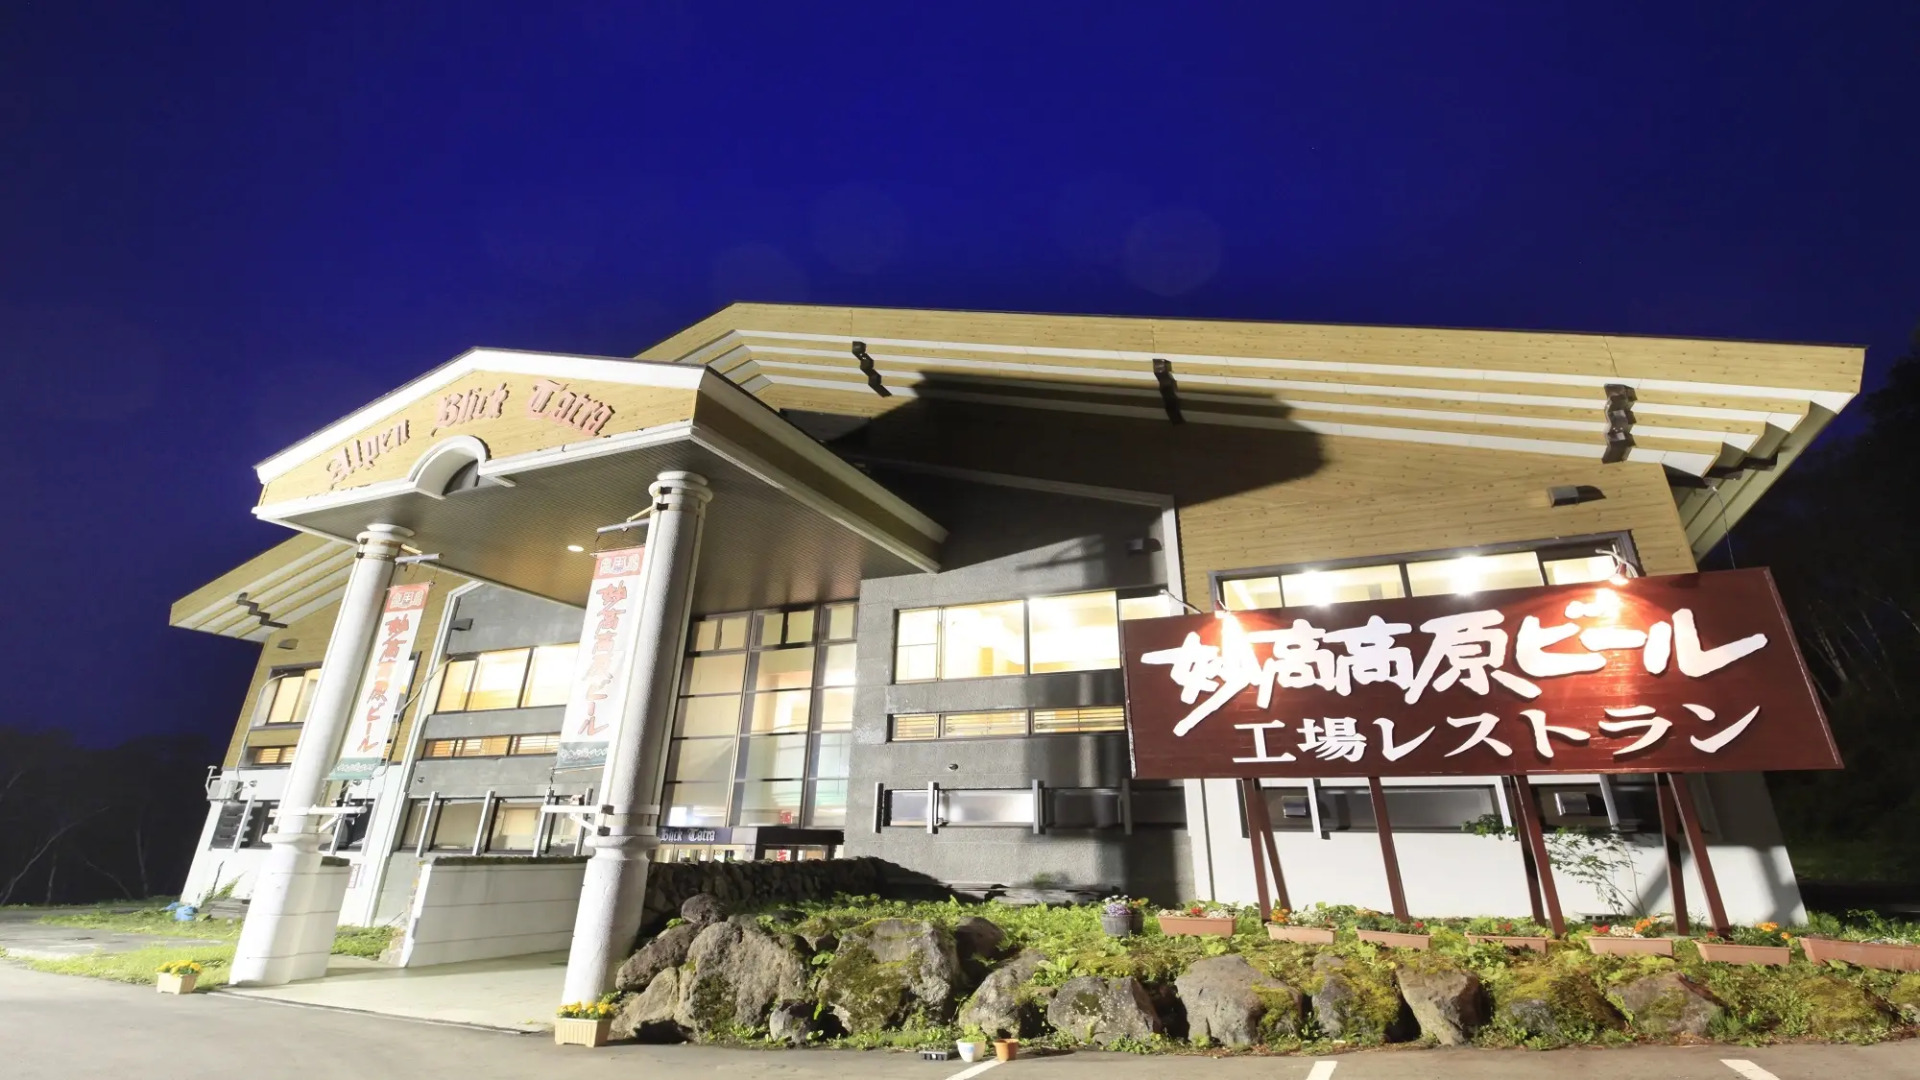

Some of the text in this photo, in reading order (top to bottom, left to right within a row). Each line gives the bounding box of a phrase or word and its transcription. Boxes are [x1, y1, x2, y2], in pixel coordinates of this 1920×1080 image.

[325, 418, 410, 490] Alpen
[431, 382, 510, 437] Blick
[1141, 594, 1768, 737] 妙高高原ビール
[1232, 703, 1761, 763] 工場レストラン
